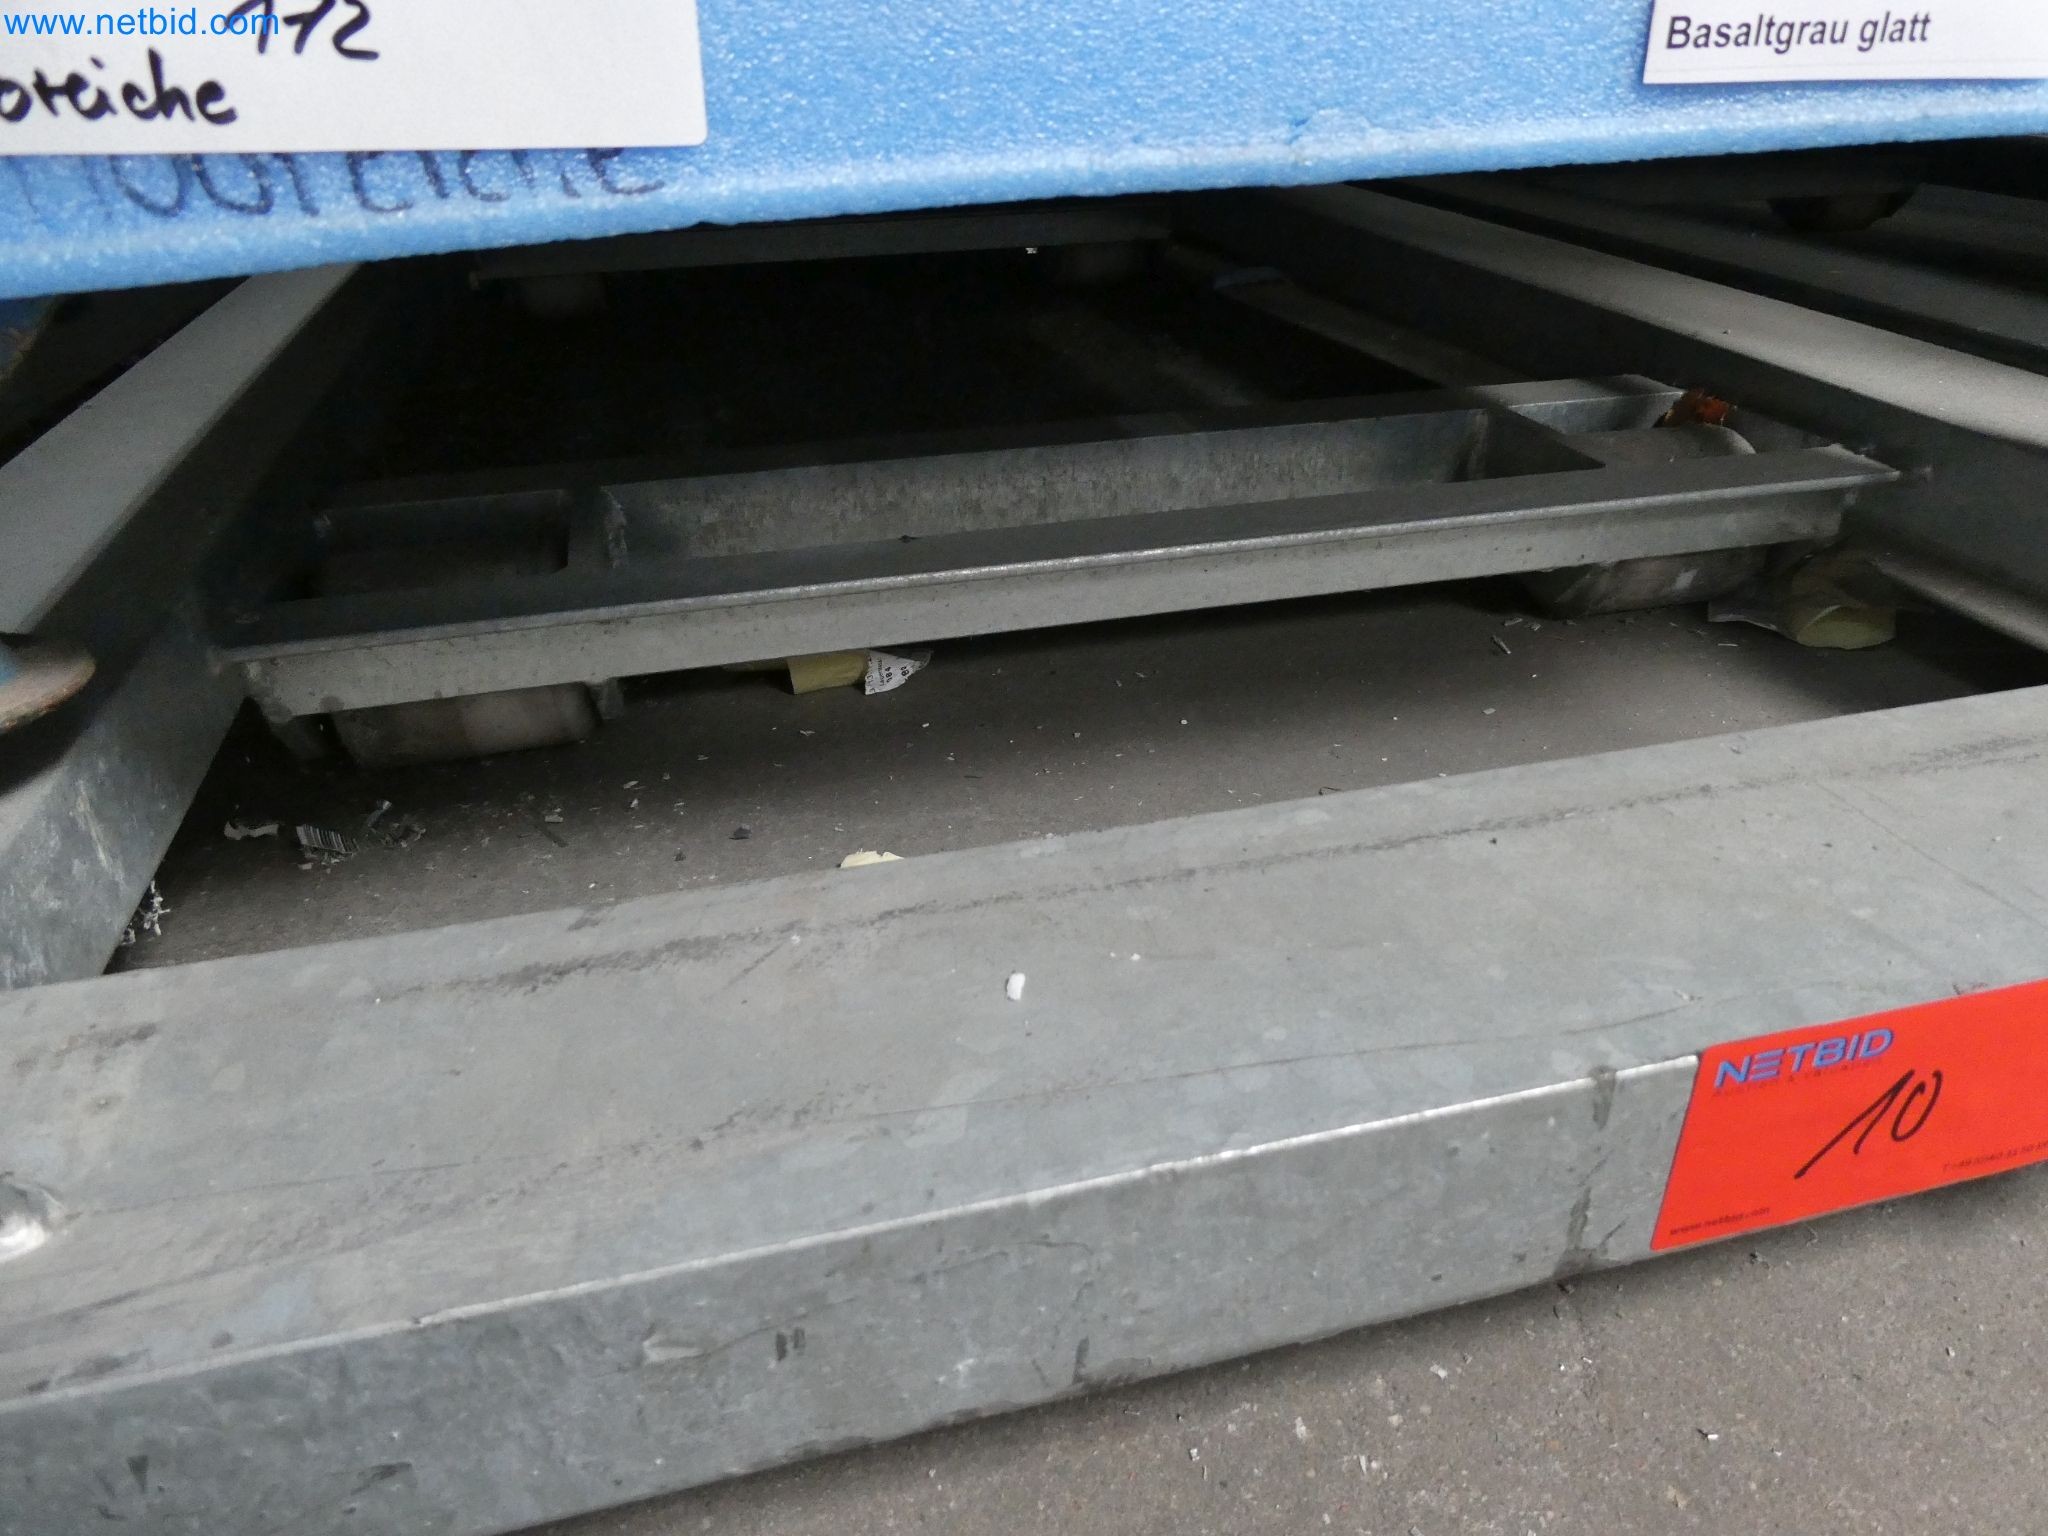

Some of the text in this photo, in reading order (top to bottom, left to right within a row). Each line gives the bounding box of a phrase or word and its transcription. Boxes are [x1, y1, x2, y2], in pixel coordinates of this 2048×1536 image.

[1665, 11, 1932, 54] Basaltgrau glatt
[1713, 1028, 1895, 1088] NETBID
[1794, 1069, 1943, 1180] 10
